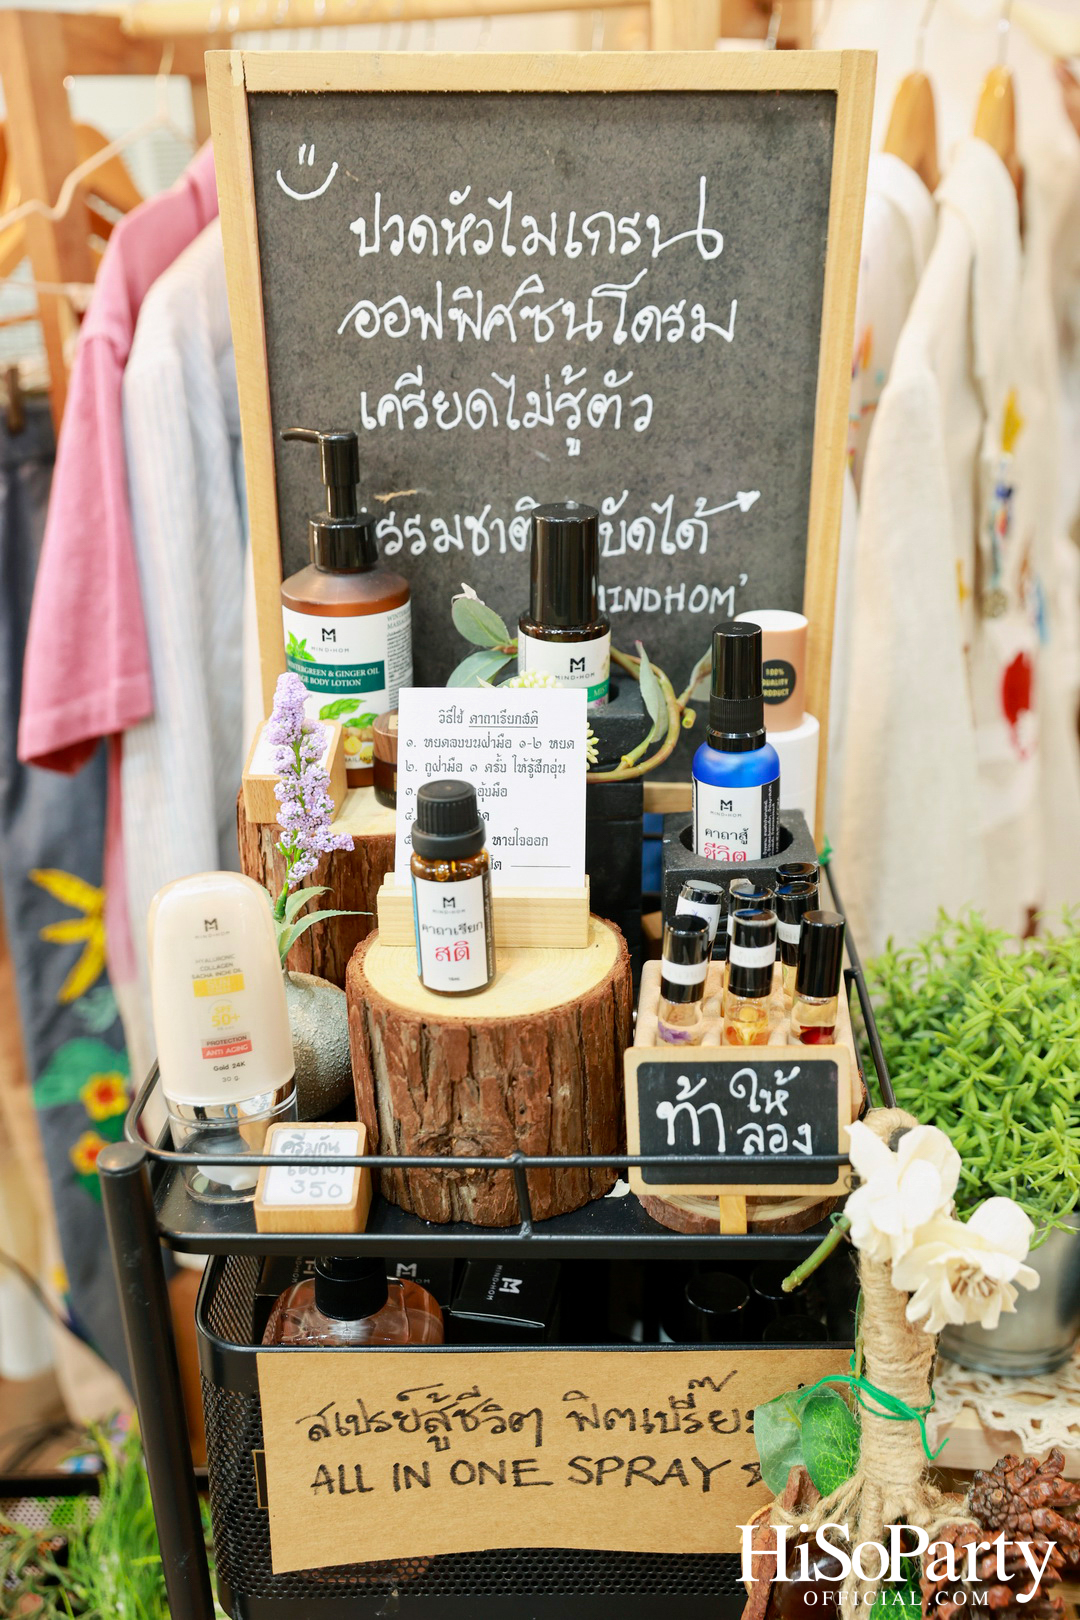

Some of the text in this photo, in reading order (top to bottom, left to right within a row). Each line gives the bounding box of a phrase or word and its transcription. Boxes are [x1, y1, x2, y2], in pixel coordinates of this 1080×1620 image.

[349, 175, 724, 261] ปวดหัวไมเกรน
[360, 366, 654, 457] เครียดไม่รู้ตัว
[335, 669, 366, 677] GINGER
[367, 667, 380, 675] OIL
[310, 678, 330, 687] BODY
[331, 679, 361, 687] LOTION
[438, 705, 539, 725] วิธีใช้ คาถาเรียกสติ
[549, 738, 575, 750] หยด
[705, 828, 749, 845] คาถาสู้
[422, 921, 484, 936] คาถาเรียก
[435, 940, 470, 962] สติ
[207, 1035, 247, 1046] PROTECTION
[206, 1044, 249, 1057] ANTI AGING
[232, 1061, 246, 1069] 24K
[656, 1066, 800, 1153] ท้า ให้
[736, 1122, 813, 1155] ลอง
[290, 1180, 343, 1198] 350
[310, 1455, 732, 1496] ALL IN ONE SPRAY
